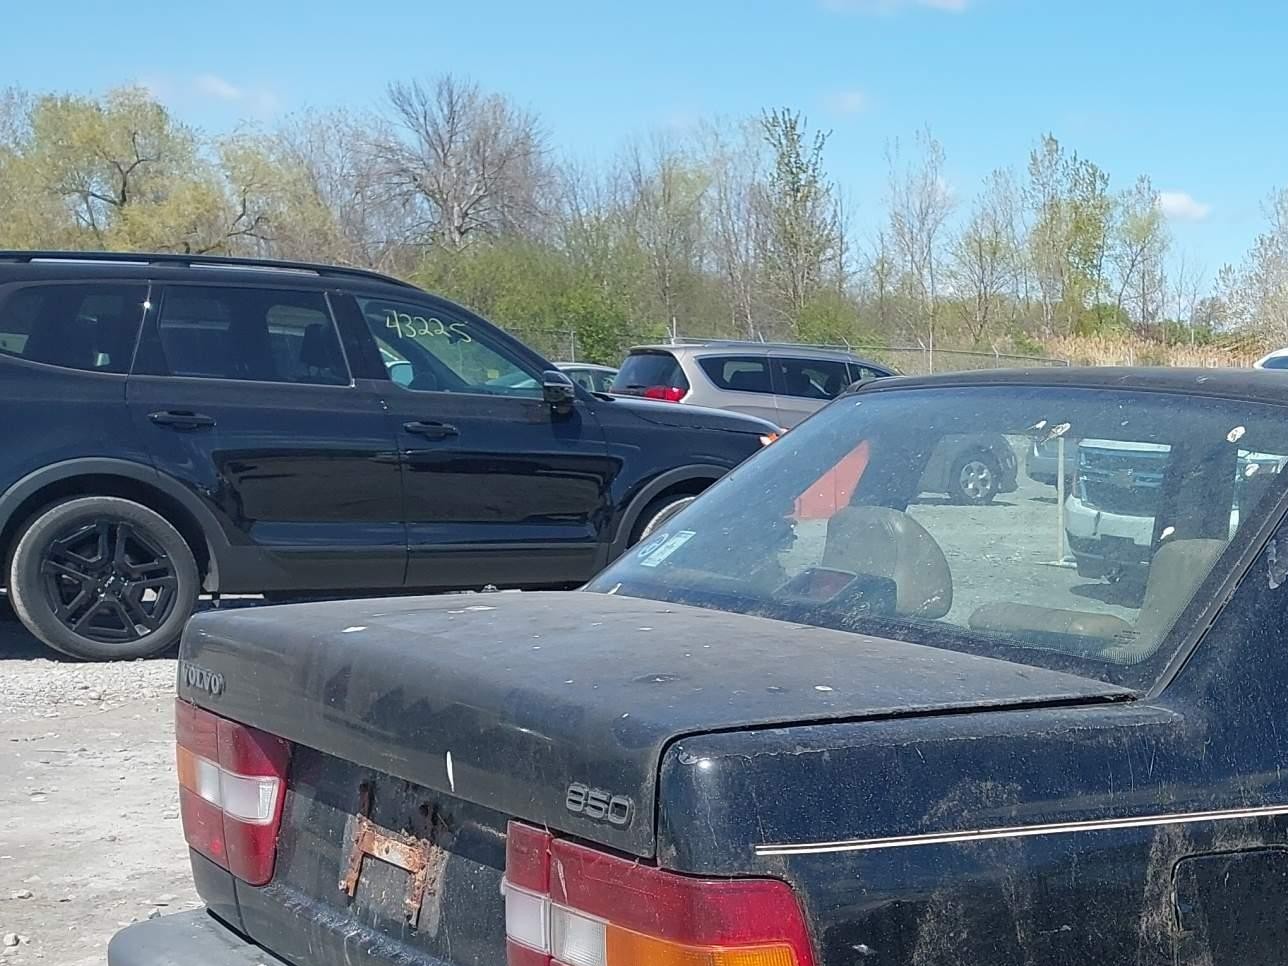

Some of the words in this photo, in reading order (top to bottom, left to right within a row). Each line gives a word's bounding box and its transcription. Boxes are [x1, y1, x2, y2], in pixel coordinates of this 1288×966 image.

[383, 308, 472, 343] 43225
[183, 663, 223, 695] VOLVO
[565, 782, 635, 830] 850
